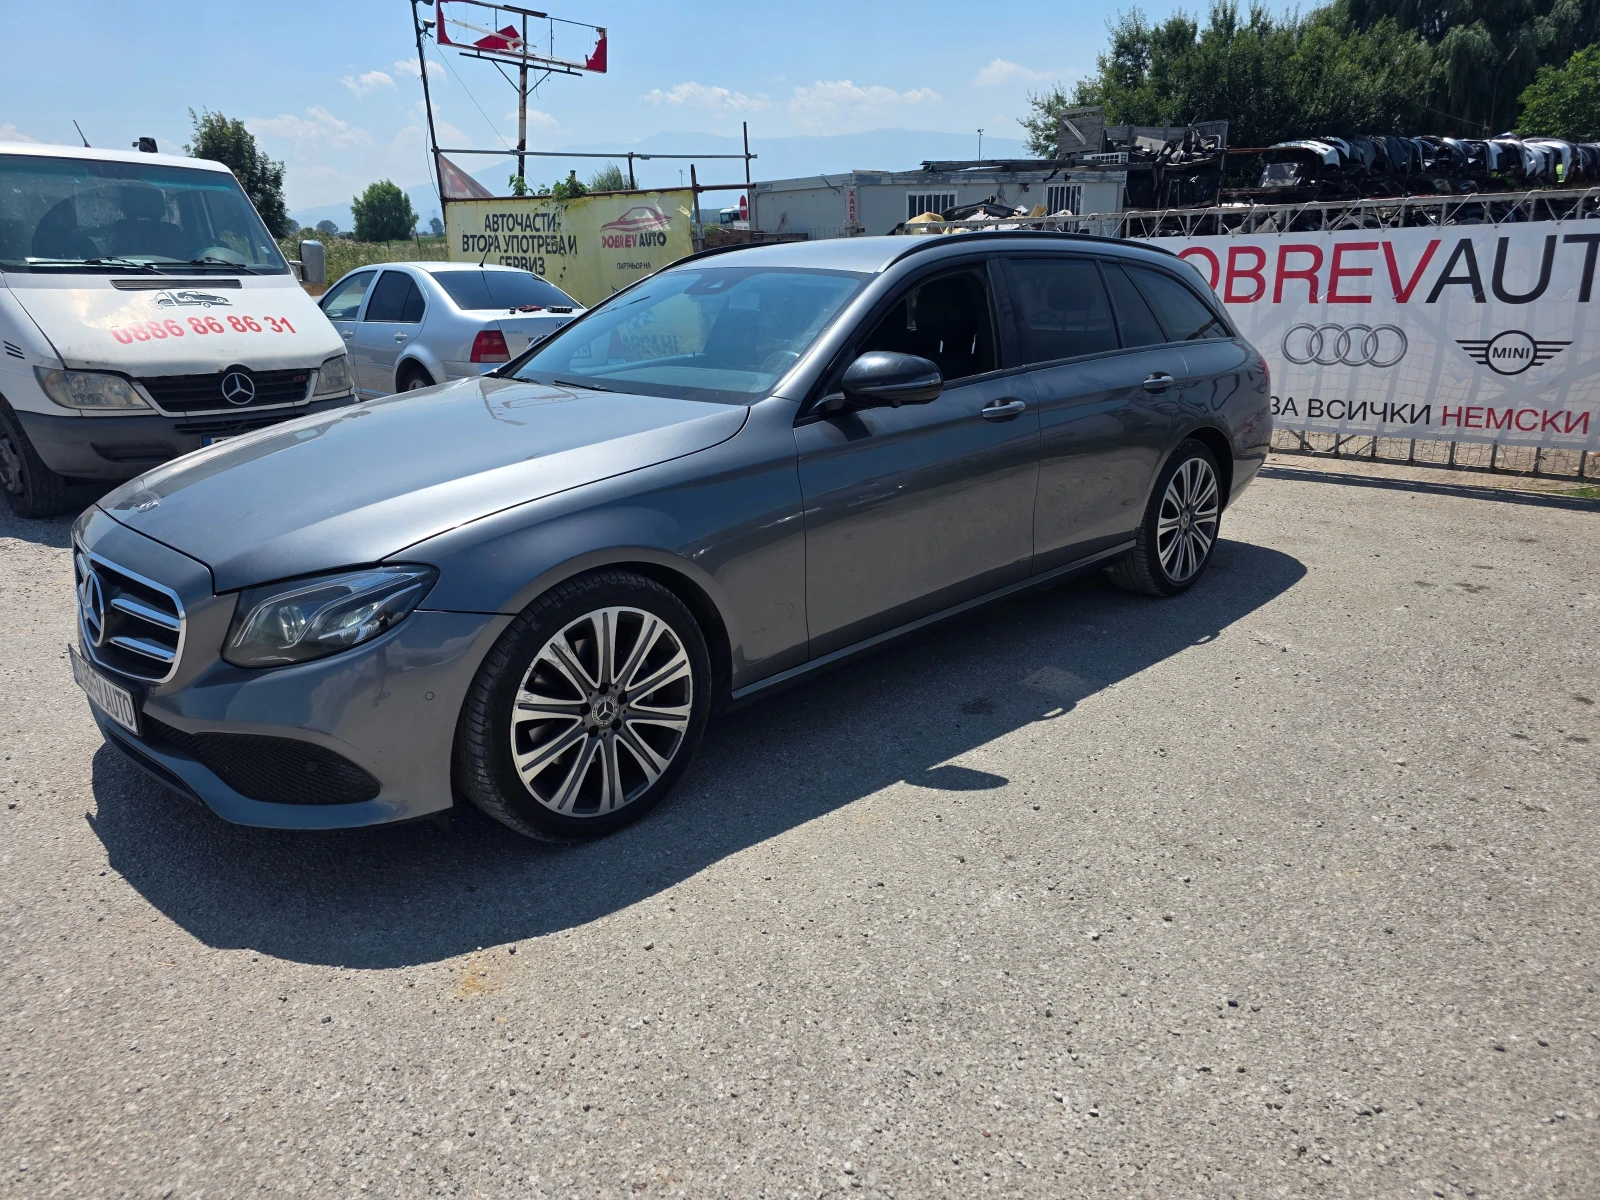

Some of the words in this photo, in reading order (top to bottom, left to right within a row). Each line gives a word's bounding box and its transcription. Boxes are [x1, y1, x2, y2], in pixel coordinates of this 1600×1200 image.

[484, 212, 557, 233] АВТОЧАСТИ
[462, 234, 502, 253] ВТОРА
[503, 234, 567, 255] УПОТРЕБА
[568, 235, 578, 255] И
[601, 233, 637, 249] DOBREV
[639, 231, 667, 248] AUTO
[617, 262, 643, 270] ПАРТНЬОР
[111, 319, 185, 345] 0886
[187, 316, 225, 335] 86
[226, 315, 263, 333] 86
[263, 316, 297, 334] 31
[1492, 347, 1531, 359] MINI
[1270, 396, 1299, 417] ЗА
[1308, 397, 1431, 426] ВСИЧКИ
[1442, 405, 1590, 435] НЕМСКИ
[104, 682, 134, 727] AUTO
